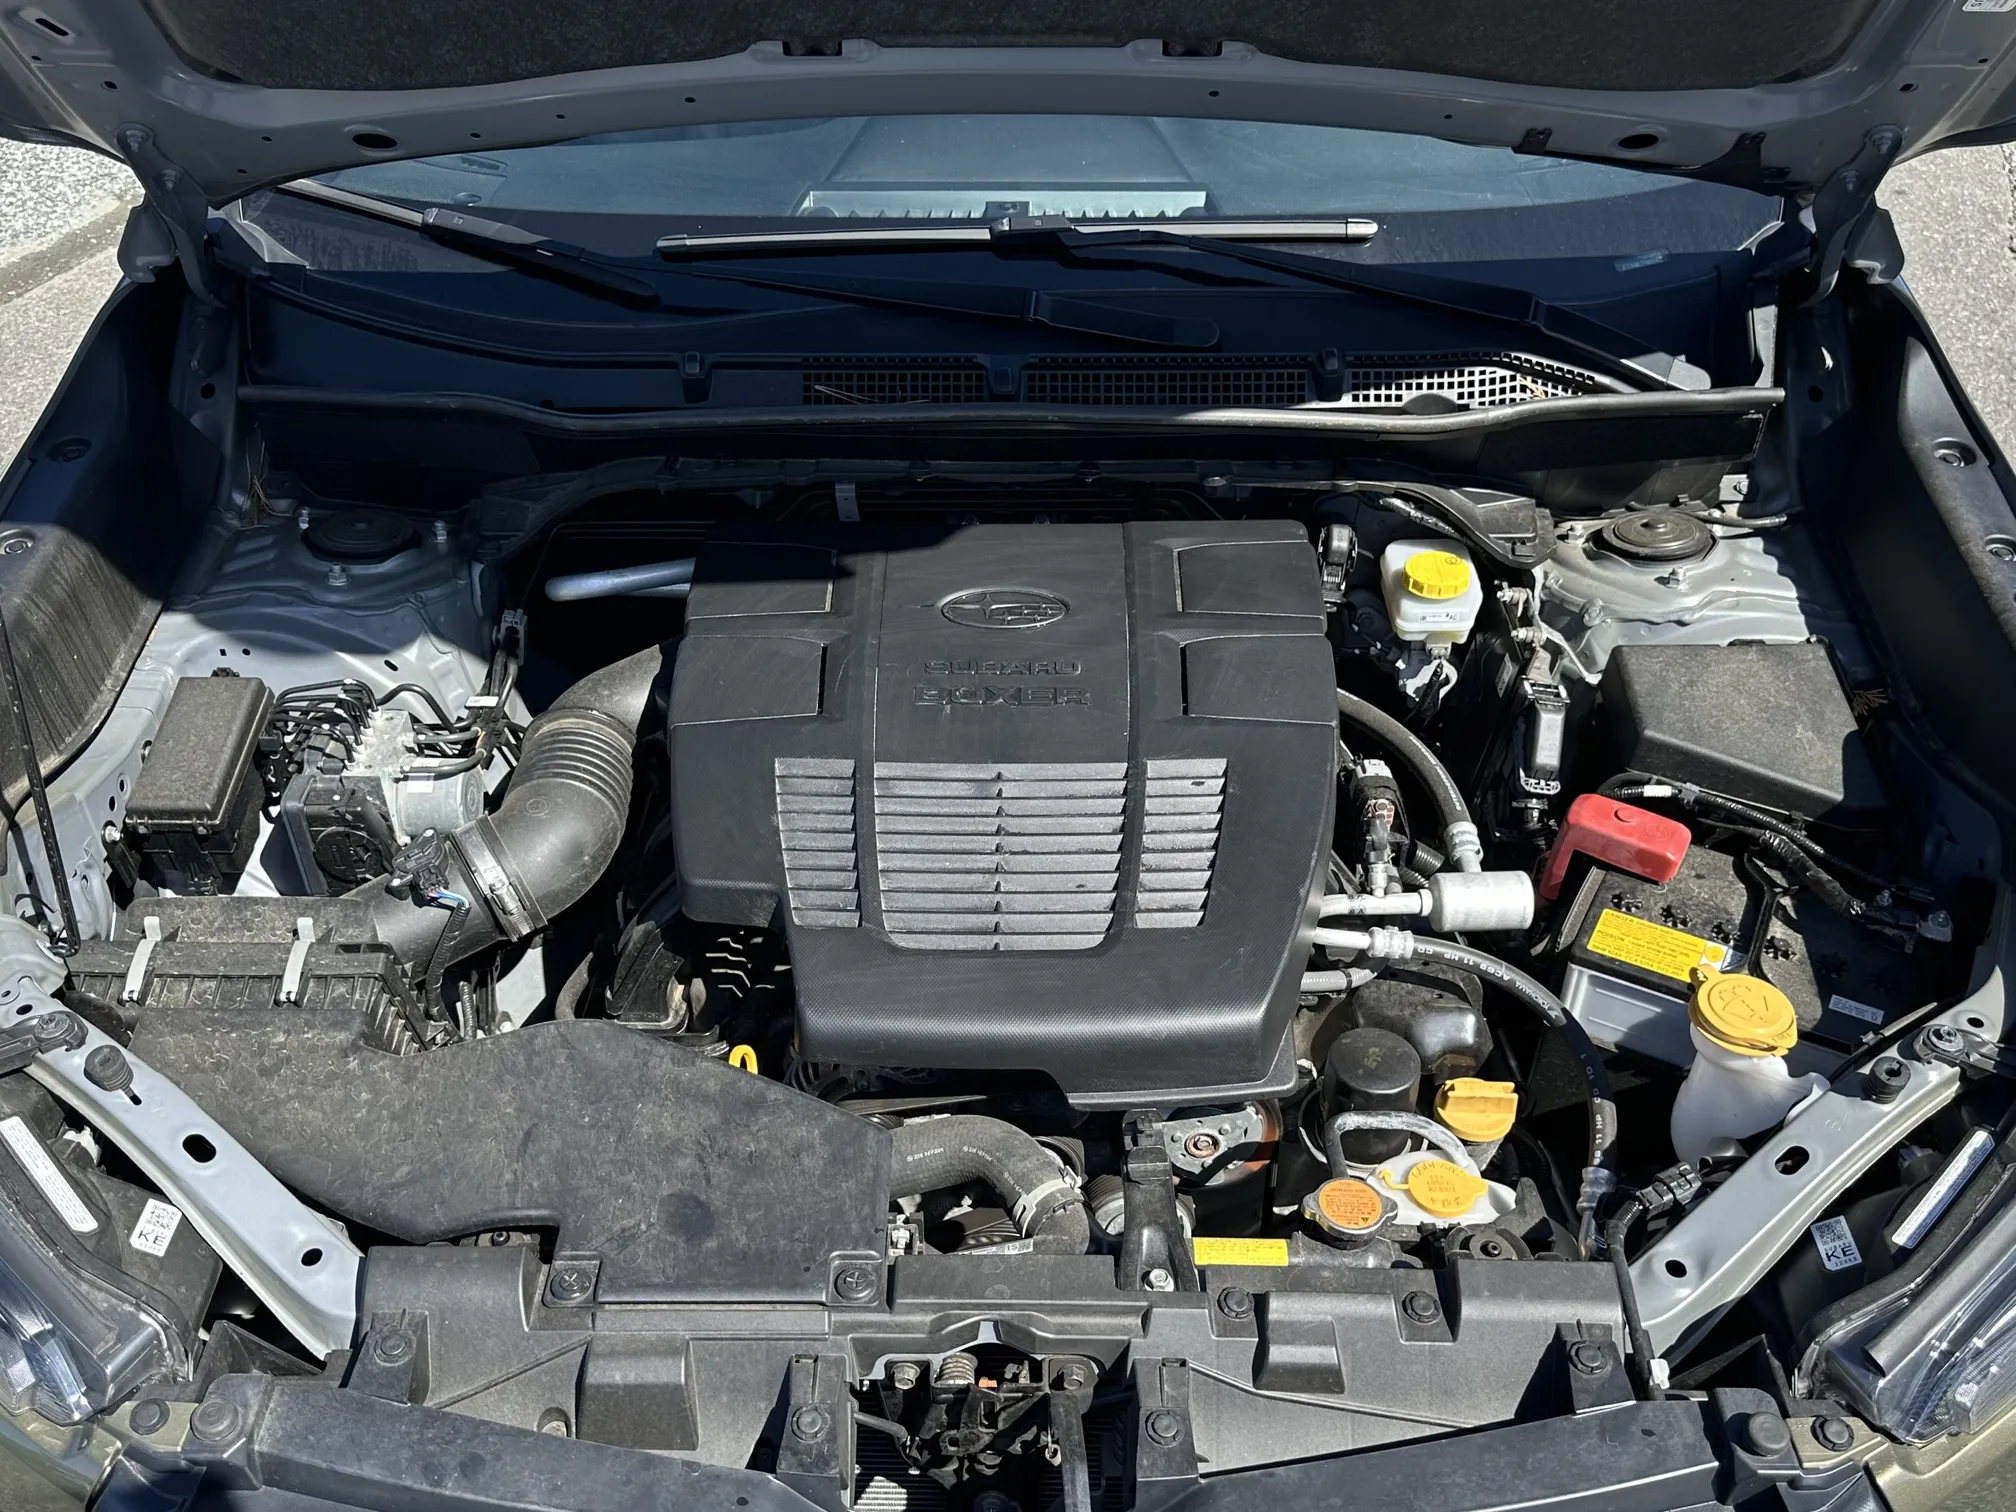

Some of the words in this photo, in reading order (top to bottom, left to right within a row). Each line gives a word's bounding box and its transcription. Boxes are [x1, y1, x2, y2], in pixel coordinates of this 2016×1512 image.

[924, 660, 1081, 676] SUBARU
[913, 686, 1091, 707] BOXER
[1604, 911, 1634, 923] DANGER
[1596, 929, 1625, 942] POISON
[1444, 952, 1459, 961] HP
[1463, 957, 1474, 966] 11
[1514, 981, 1550, 1011] YOKOHAMA
[1596, 1114, 1603, 1128] HP
[1596, 1133, 1602, 1144] 11
[138, 1230, 166, 1247] KE
[1826, 1246, 1854, 1262] KE
